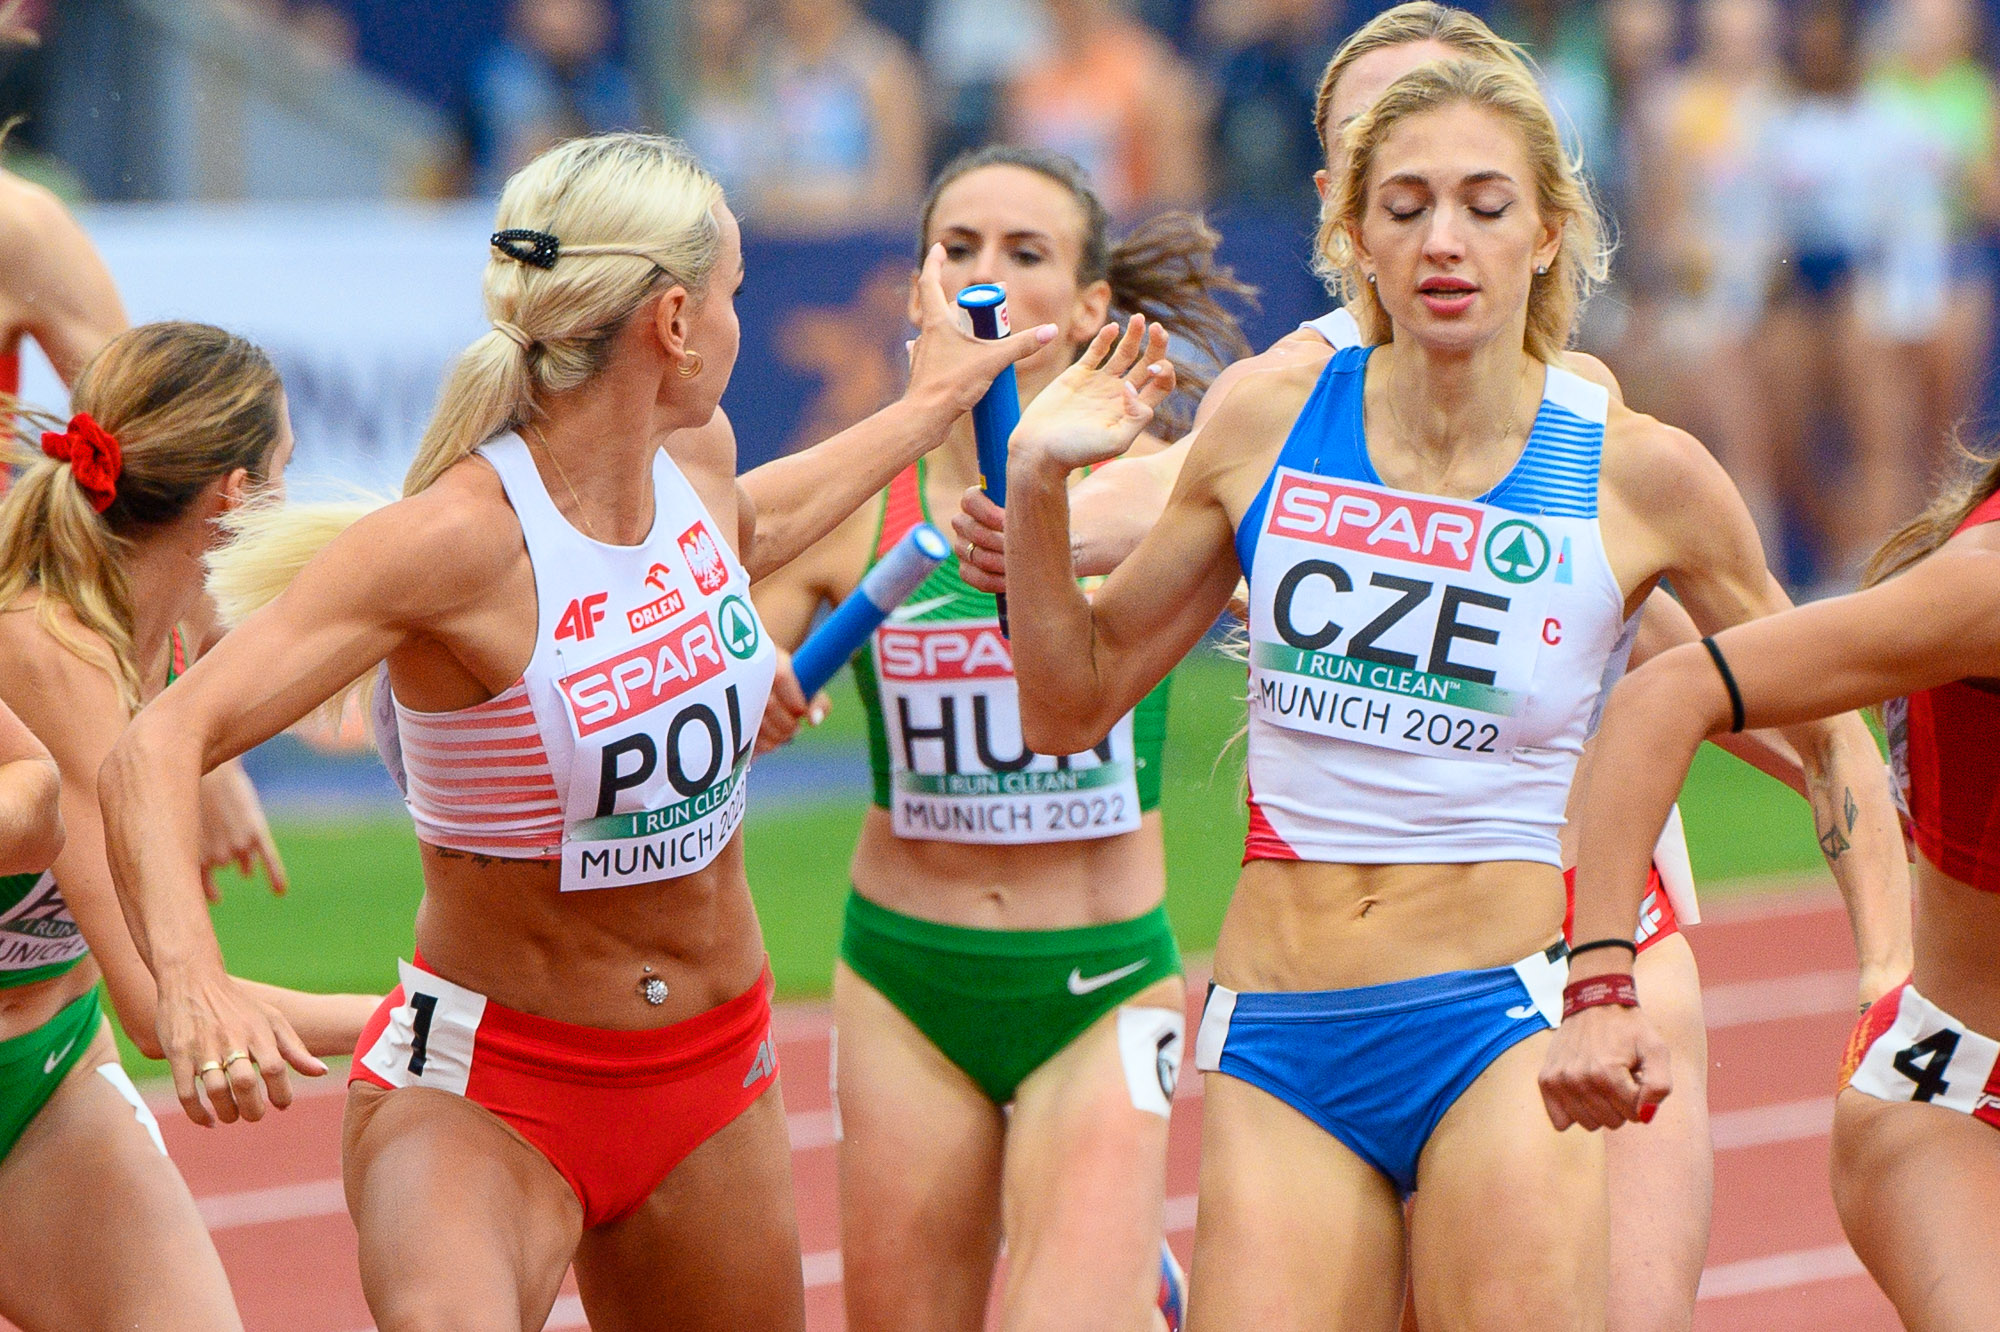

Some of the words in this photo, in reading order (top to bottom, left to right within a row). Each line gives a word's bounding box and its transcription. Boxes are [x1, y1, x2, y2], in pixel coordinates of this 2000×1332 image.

[1277, 486, 1474, 561] SPAR
[554, 591, 608, 641] 4F
[632, 593, 681, 630] ORLEN
[1273, 559, 1511, 686] CZE
[570, 622, 720, 726] SPAR
[881, 631, 1014, 677] SPA
[1295, 652, 1304, 671] I
[1309, 657, 1364, 684] RUN
[595, 684, 753, 819] POL
[1260, 678, 1391, 734] MUNICH
[1403, 709, 1499, 753] 2022
[632, 816, 638, 835] I
[647, 804, 690, 832] RUN
[904, 801, 1033, 833] MUNICH
[1046, 793, 1125, 831] 2022
[941, 776, 947, 793] I
[951, 775, 999, 793] RUN
[581, 834, 713, 880] MUNICH
[717, 780, 747, 843] 2022
[0, 938, 80, 963] UNICH
[408, 991, 438, 1077] 1
[1156, 1031, 1177, 1104] 6
[1893, 1028, 1962, 1102] 4
